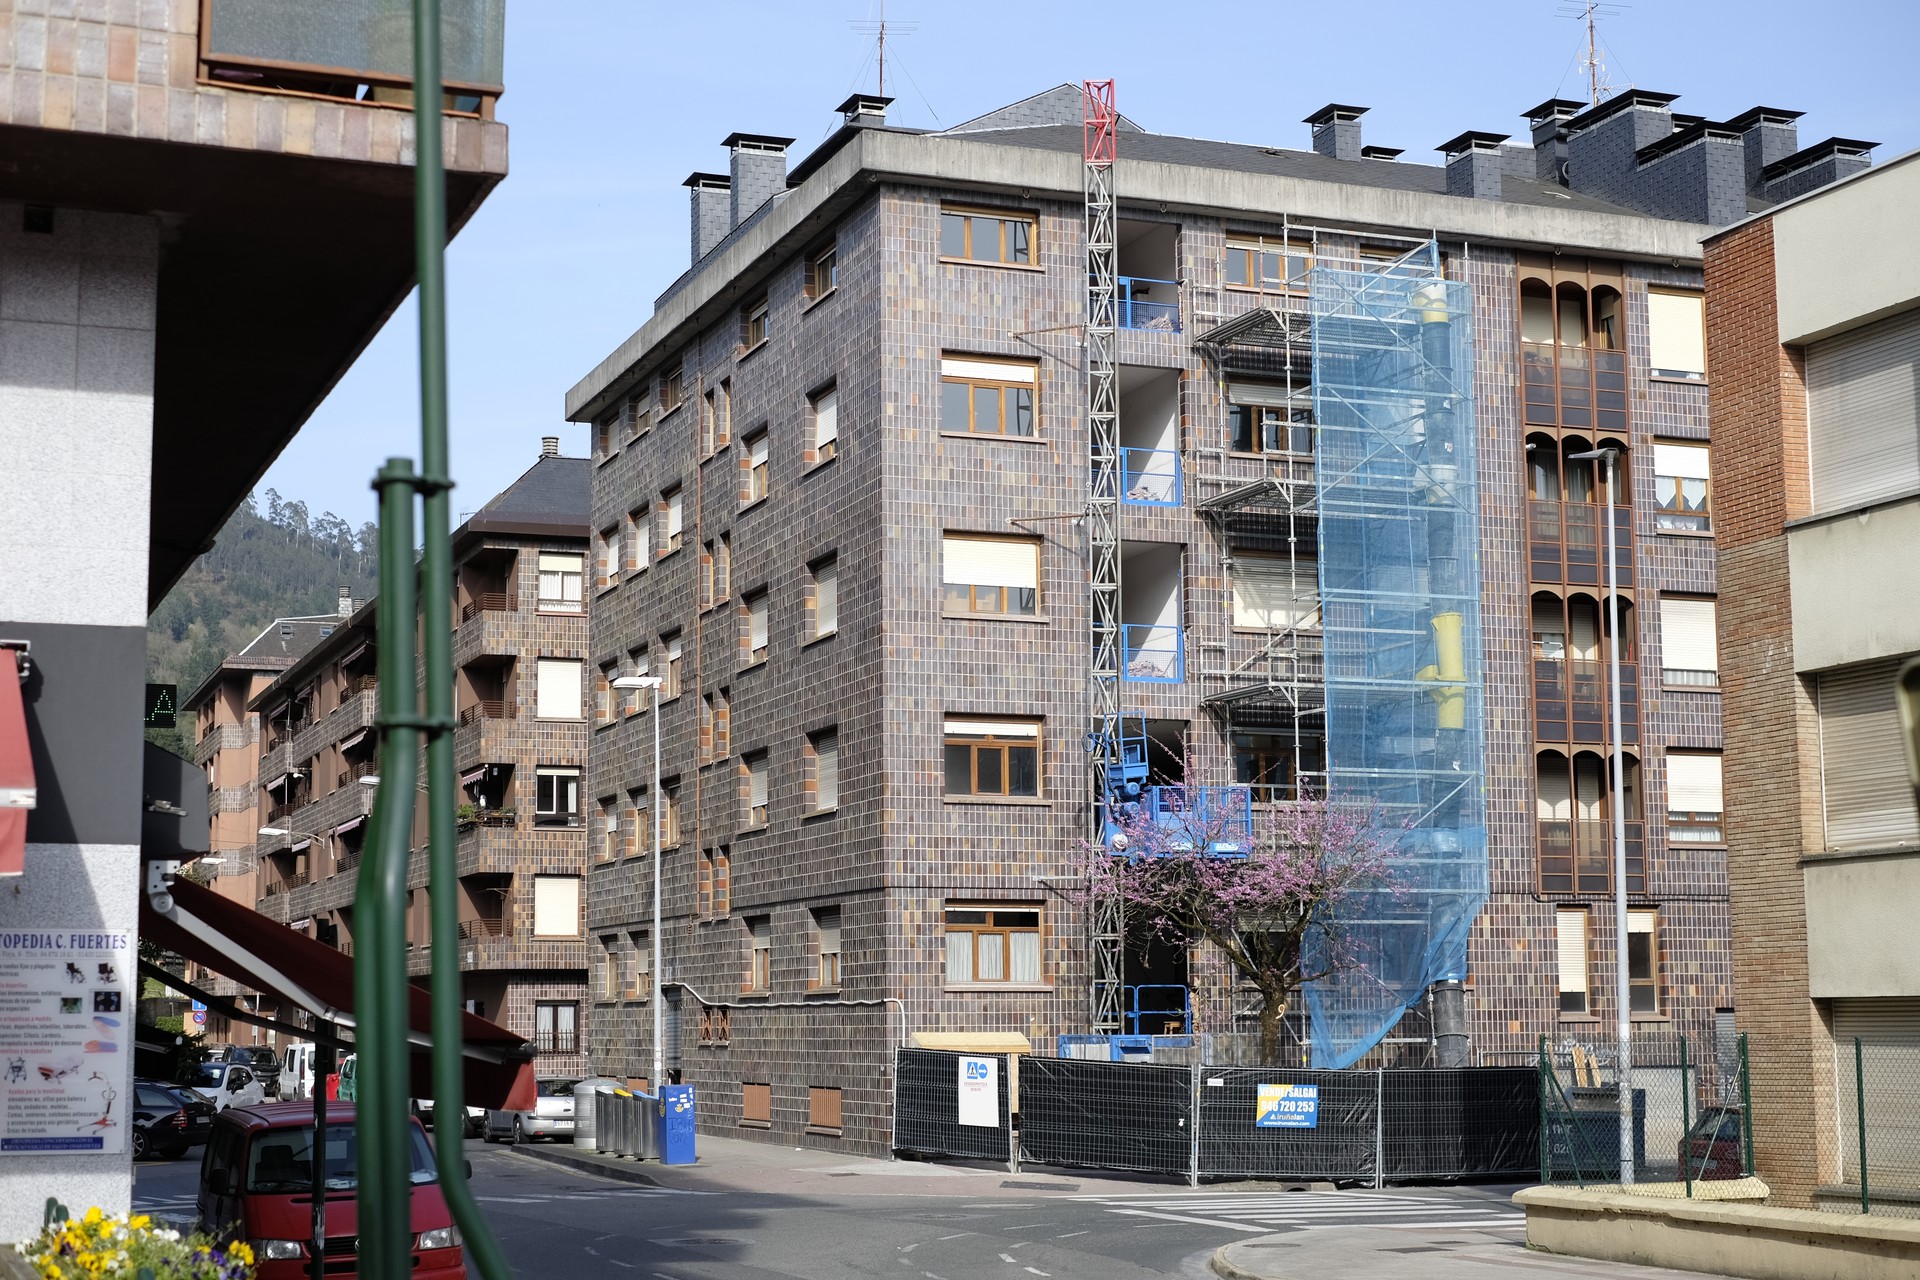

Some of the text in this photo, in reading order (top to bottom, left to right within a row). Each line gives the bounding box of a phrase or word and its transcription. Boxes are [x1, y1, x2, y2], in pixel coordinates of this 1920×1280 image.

[56, 934, 67, 949] C.
[70, 934, 127, 949] FUERTES
[1259, 1087, 1316, 1098] VENDE/SALGAI
[1261, 1101, 1314, 1112] 946 720 253
